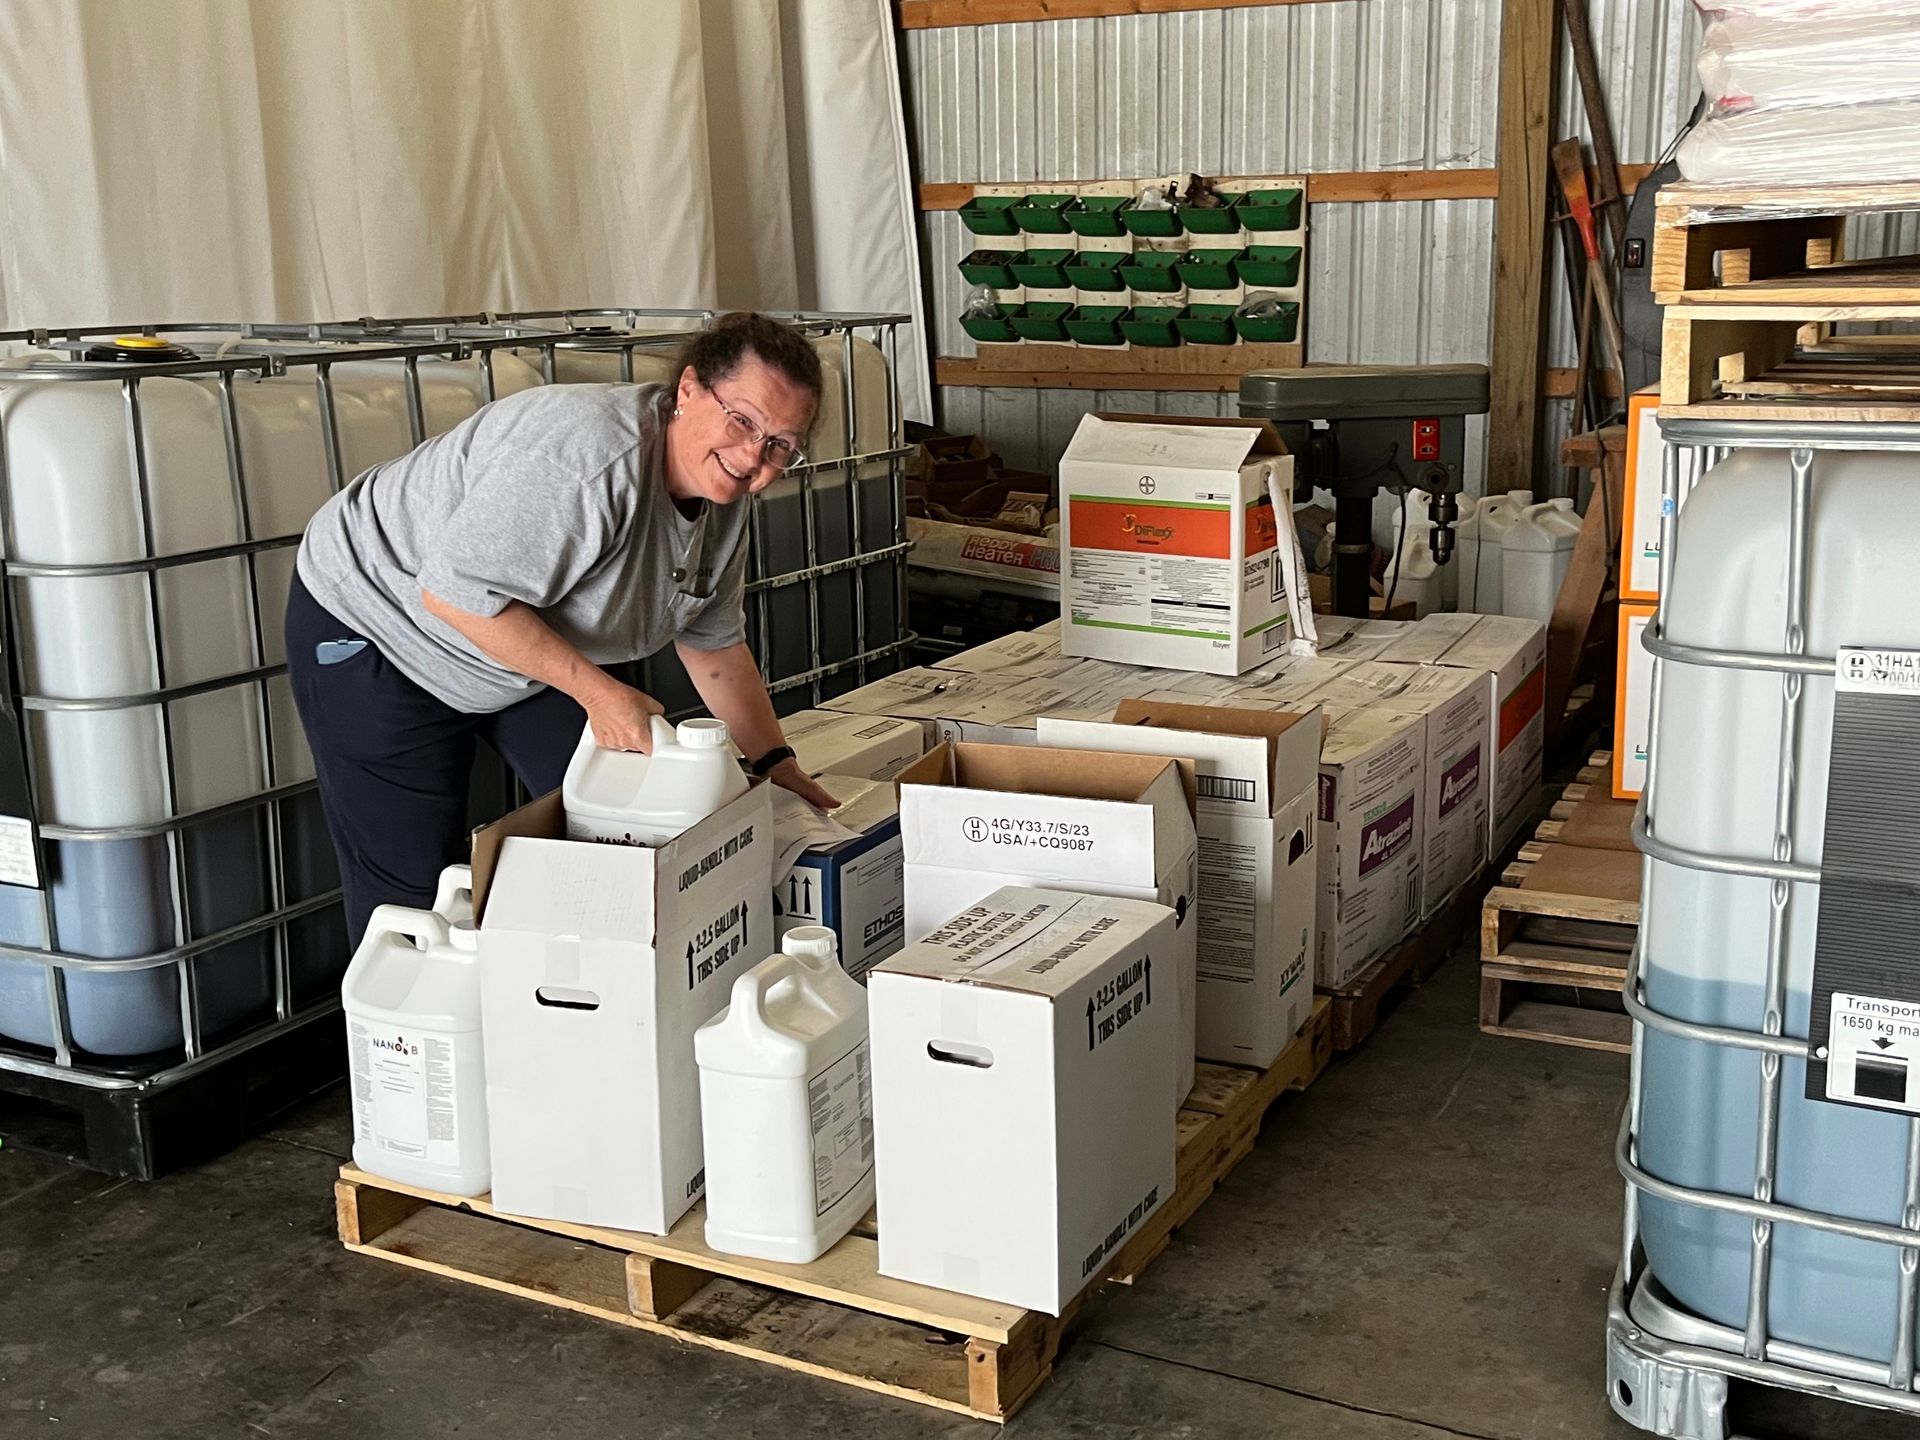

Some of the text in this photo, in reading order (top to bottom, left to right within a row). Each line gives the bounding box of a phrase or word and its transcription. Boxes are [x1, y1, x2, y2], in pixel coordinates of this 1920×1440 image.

[724, 836, 738, 861] WITH
[739, 825, 754, 850] CARE
[991, 818, 1090, 836] 4G/Y33.7/S/23
[992, 832, 1094, 851] USA/+CQ9087
[1362, 816, 1412, 862] Atrazine
[714, 903, 740, 939] GALLON
[864, 905, 904, 939] ETHOS
[920, 906, 991, 945] THIS SIDE UP
[697, 934, 741, 983] THIS SIDE UP
[1116, 958, 1143, 996] GALLON
[1098, 991, 1144, 1044] THIS SIDE UP
[1842, 1015, 1920, 1037] 1650 kg ma
